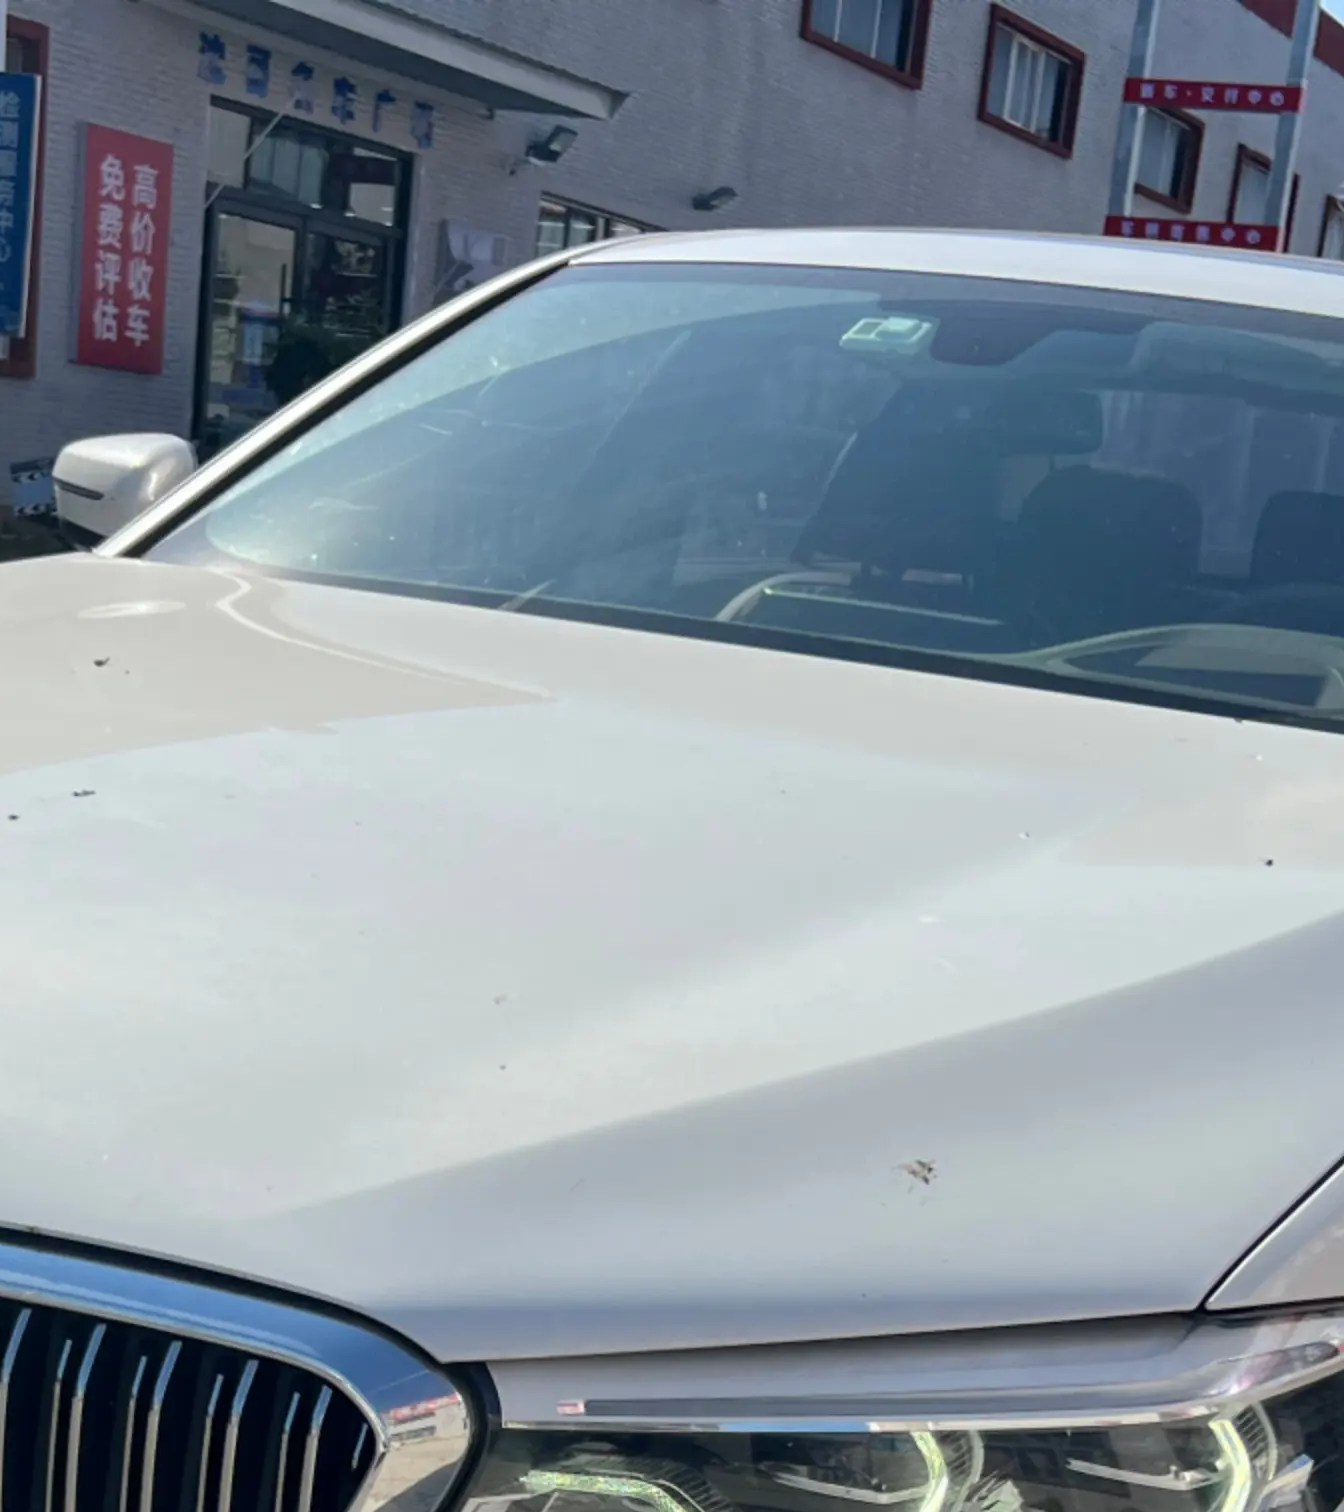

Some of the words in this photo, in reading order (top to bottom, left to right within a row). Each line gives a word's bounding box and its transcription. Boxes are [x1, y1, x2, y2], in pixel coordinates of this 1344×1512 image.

[92, 153, 127, 343] 免费评估
[124, 163, 159, 348] 高价收车
